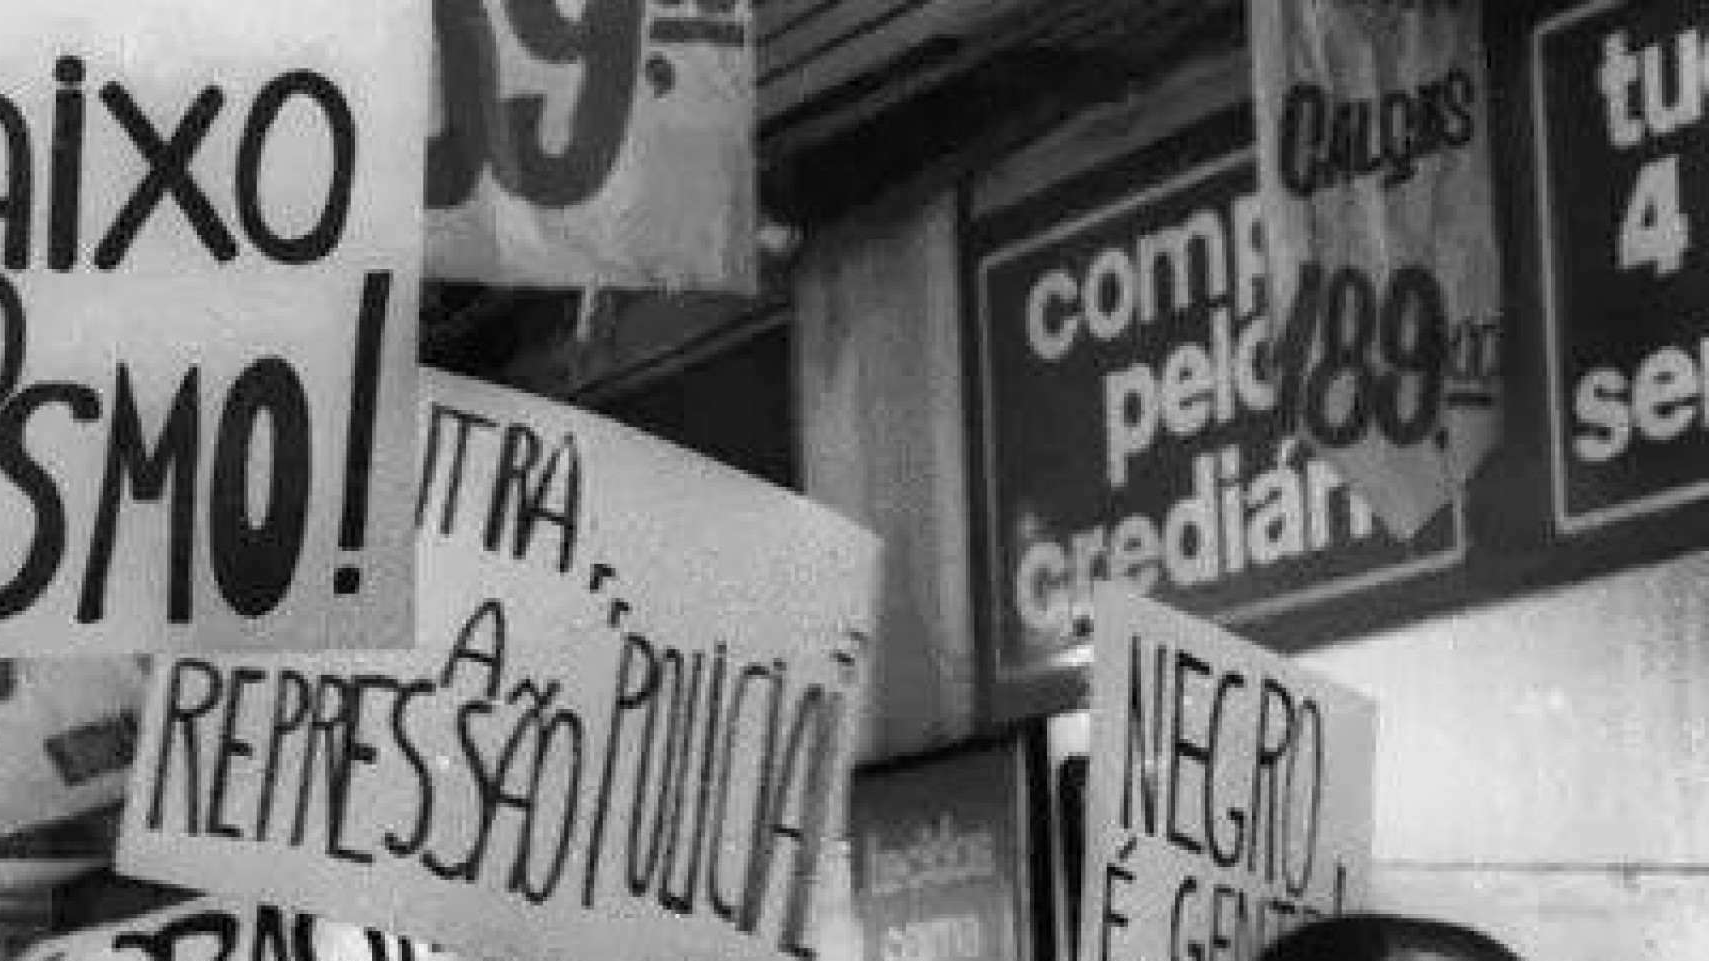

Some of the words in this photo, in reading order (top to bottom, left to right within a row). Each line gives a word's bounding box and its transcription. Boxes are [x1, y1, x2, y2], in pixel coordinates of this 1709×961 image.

[440, 600, 507, 702] A
[1122, 634, 1324, 898] NEGRO
[147, 655, 586, 904] REPRESSÃO
